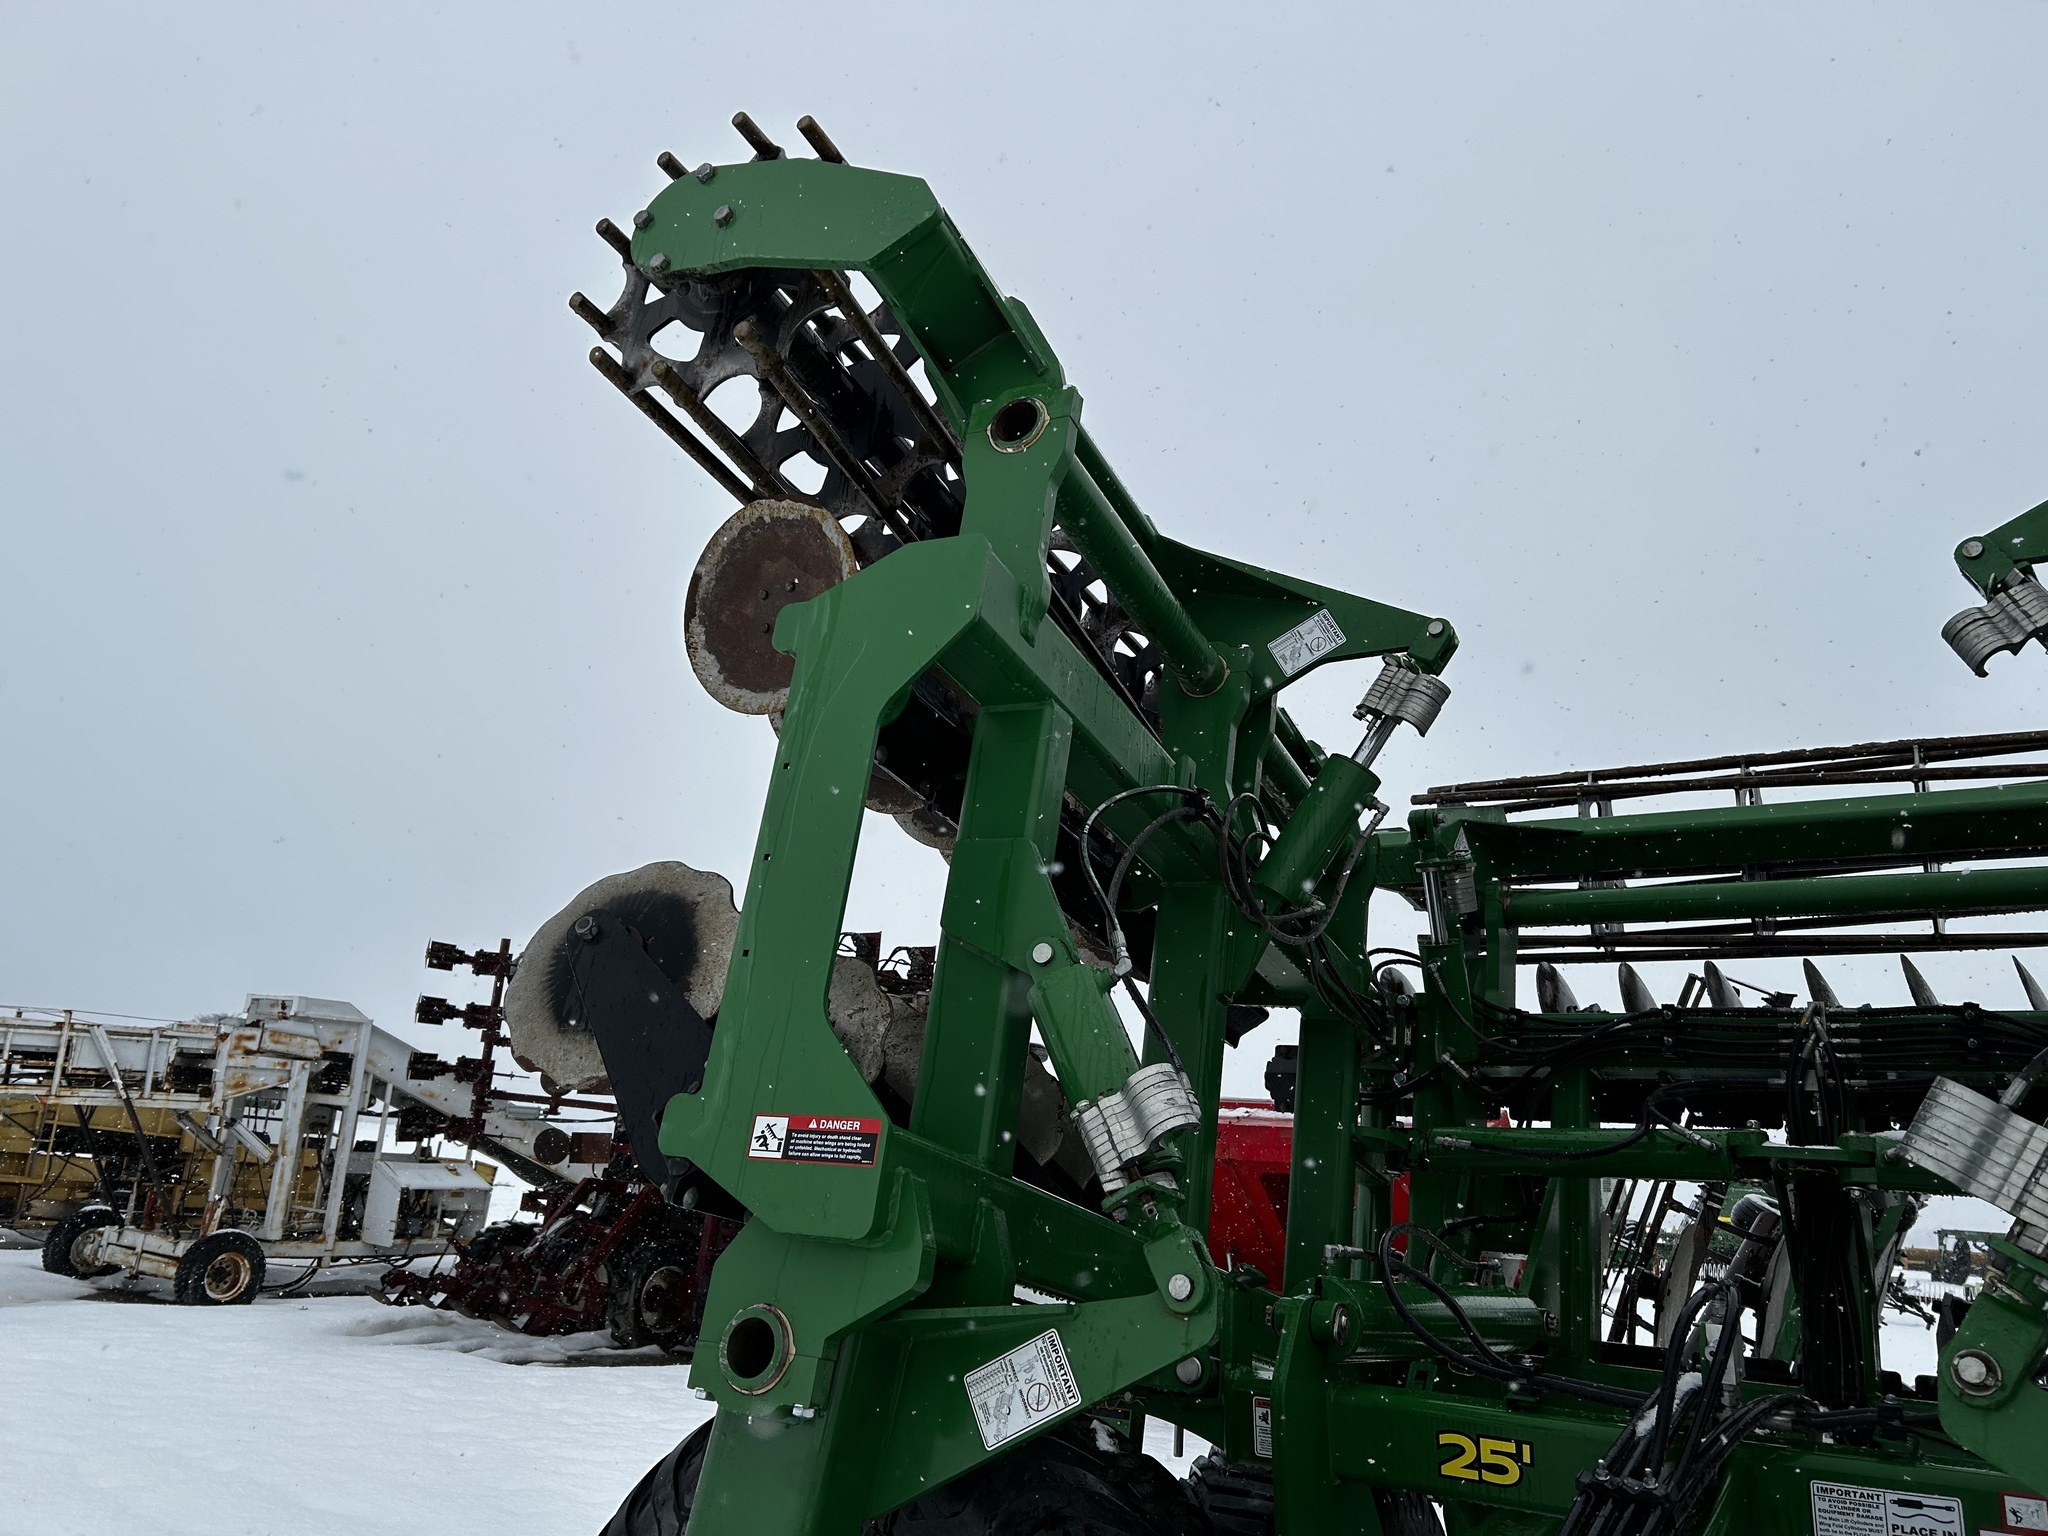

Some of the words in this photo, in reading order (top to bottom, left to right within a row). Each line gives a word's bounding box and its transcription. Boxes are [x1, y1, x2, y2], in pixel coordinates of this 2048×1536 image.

[1320, 612, 1342, 642] IMPORTANT
[820, 1120, 860, 1130] DANGER
[1046, 1334, 1076, 1402] IMPORTANT
[1816, 1486, 1882, 1501] IMPORTANT
[1828, 1504, 1860, 1512] CYLINDER
[1849, 1501, 1880, 1509] POSSIBLE
[1818, 1508, 1854, 1517] EQUIPMENT
[1892, 1524, 1937, 1536] PLACE
